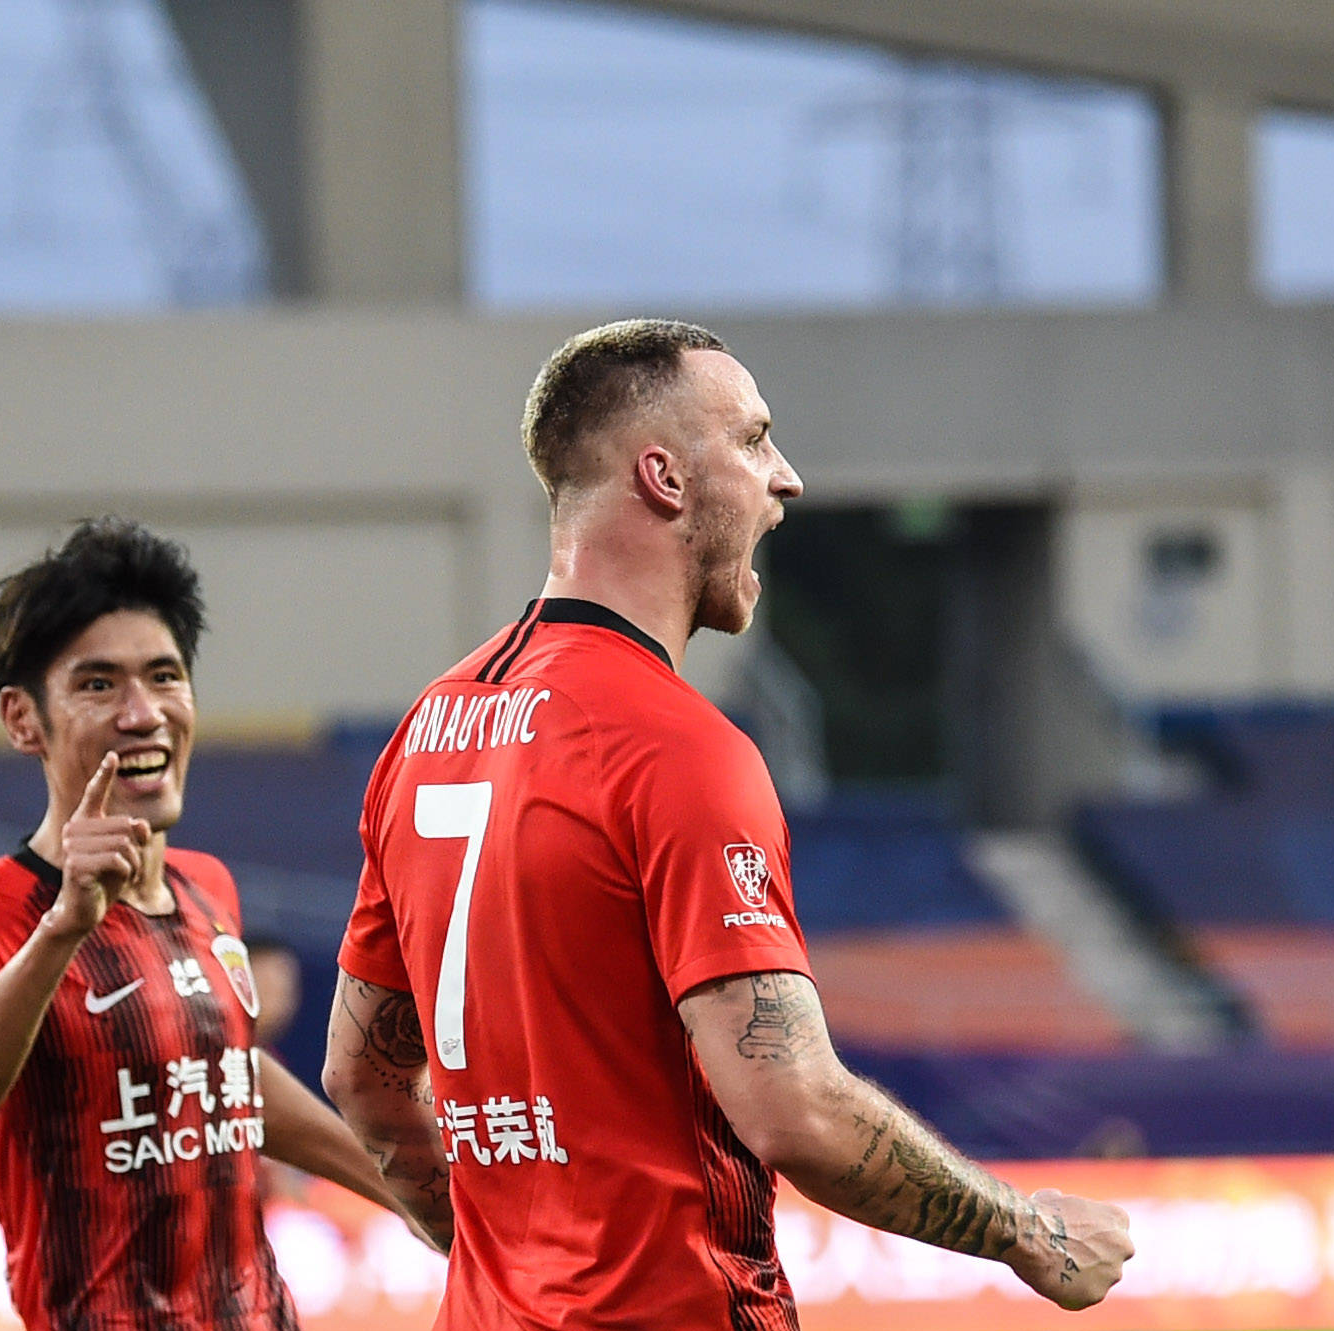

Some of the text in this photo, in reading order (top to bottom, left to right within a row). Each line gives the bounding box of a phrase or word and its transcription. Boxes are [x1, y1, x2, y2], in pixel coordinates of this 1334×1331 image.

[414, 781, 492, 1070] 7
[723, 911, 787, 929] ROEWE
[100, 1046, 264, 1134] 上汽集
[105, 1126, 201, 1173] SAIC
[432, 1095, 569, 1166] 汽荣威
